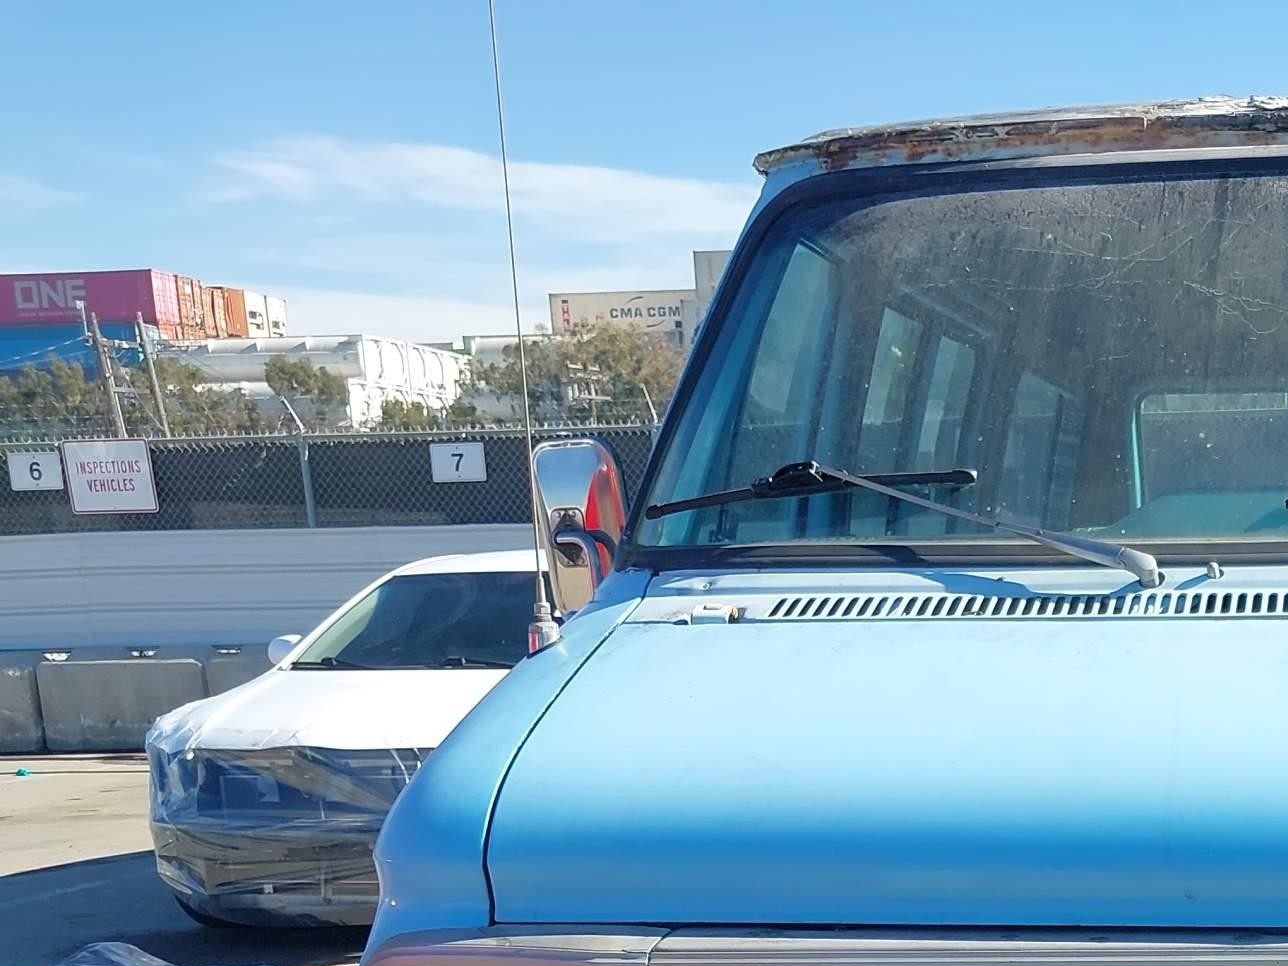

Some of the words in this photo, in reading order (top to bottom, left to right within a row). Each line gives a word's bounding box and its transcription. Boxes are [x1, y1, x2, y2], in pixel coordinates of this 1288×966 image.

[14, 279, 86, 309] ONE
[609, 307, 643, 319] CMA
[647, 305, 680, 318] CGM
[29, 461, 42, 481] 6
[75, 460, 141, 475] INSPECTIONS
[451, 453, 464, 472] 7
[86, 478, 136, 493] VEHICLES
